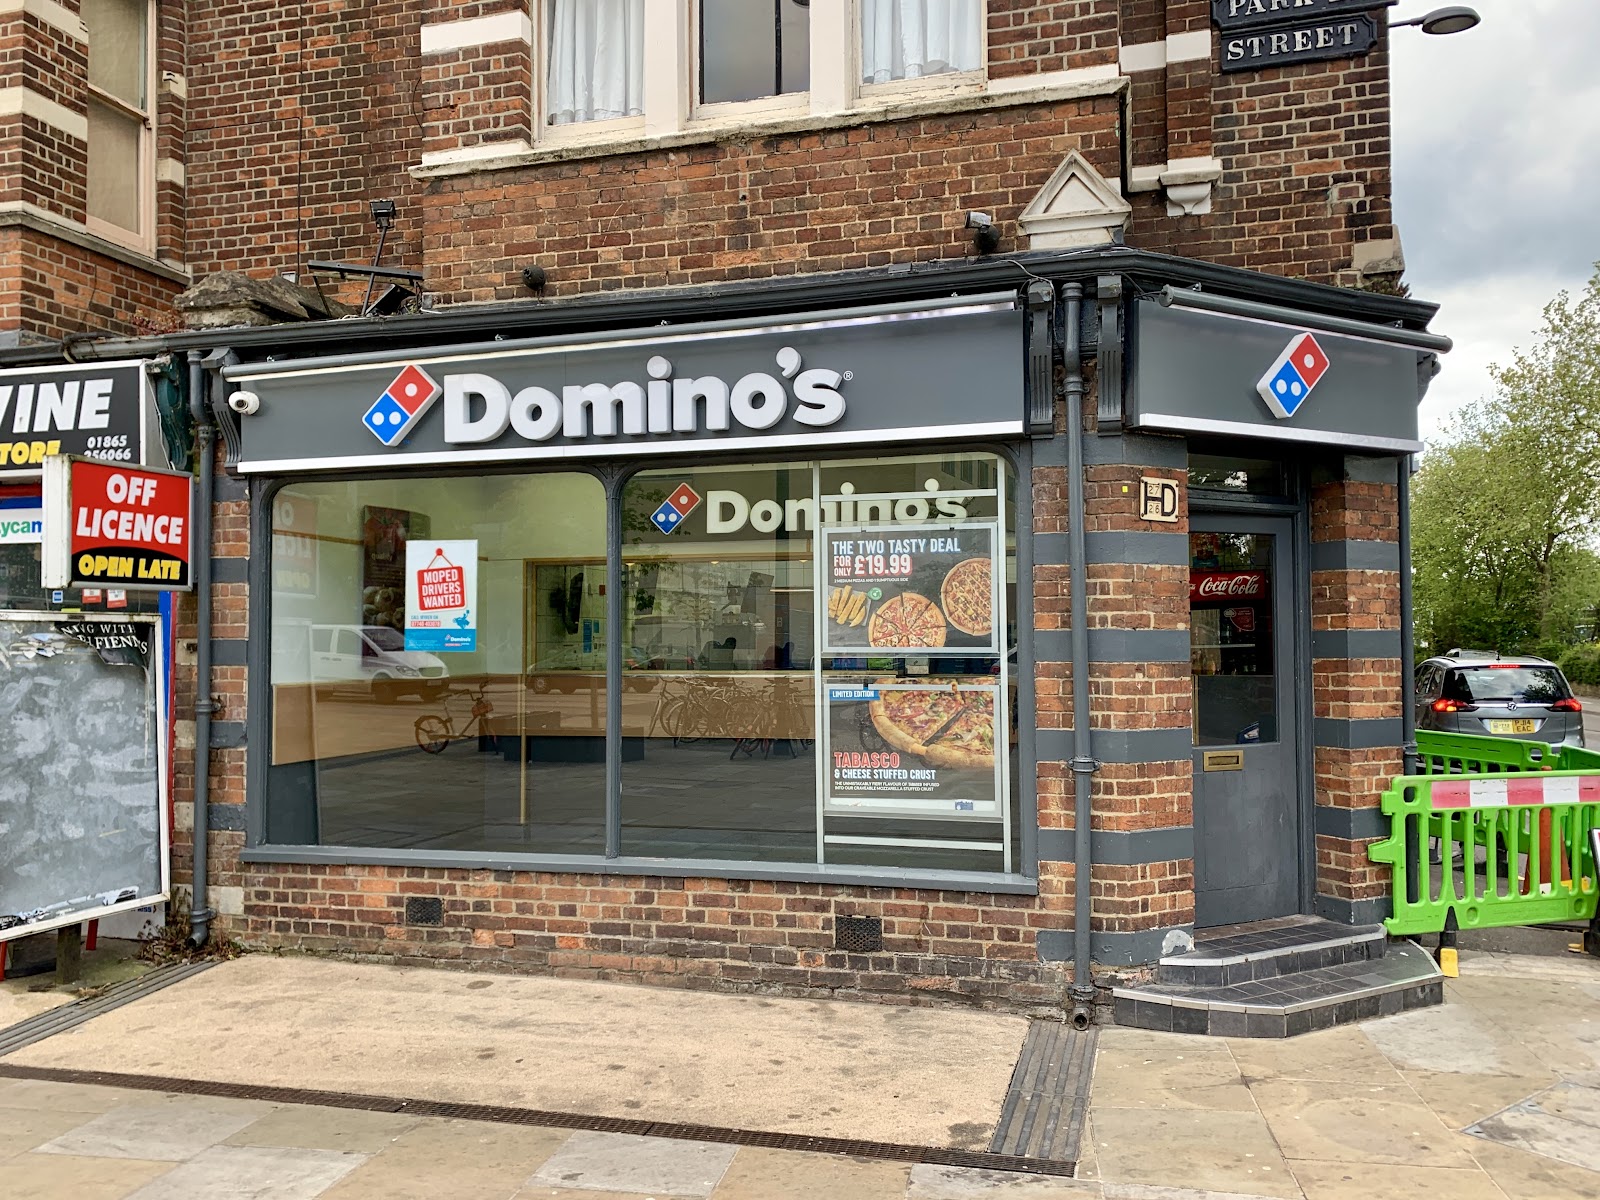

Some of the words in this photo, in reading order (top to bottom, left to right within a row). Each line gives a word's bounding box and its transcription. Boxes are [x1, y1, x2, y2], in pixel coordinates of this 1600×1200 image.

[1227, 24, 1358, 60] STREET
[444, 347, 846, 443] Domino's
[87, 435, 128, 449] 01865
[0, 440, 61, 465] TORE
[106, 474, 157, 506] OFF
[1144, 482, 1176, 516] HD
[0, 521, 42, 538] ycam
[76, 507, 183, 544] LICENCE
[832, 541, 854, 555] THE
[858, 540, 884, 554] TWO
[888, 538, 926, 554] TASTY
[930, 537, 961, 553] DEAL
[78, 554, 132, 578] OPEN
[138, 559, 181, 579] LATE
[834, 555, 851, 567] FOR
[854, 553, 912, 576] £19.99
[423, 569, 458, 584] MOPED
[834, 567, 851, 576] ONLY
[422, 582, 461, 596] DRIVERS
[1199, 575, 1260, 597] Coca-Cola
[423, 594, 461, 608] WANTED
[100, 624, 136, 634] WITH
[832, 690, 852, 698] LIMITED
[834, 752, 900, 768] TABASCO
[834, 769, 841, 779] &
[842, 769, 872, 779] CHEESE
[873, 769, 908, 780] STUFFED
[909, 770, 936, 780] CRUST
